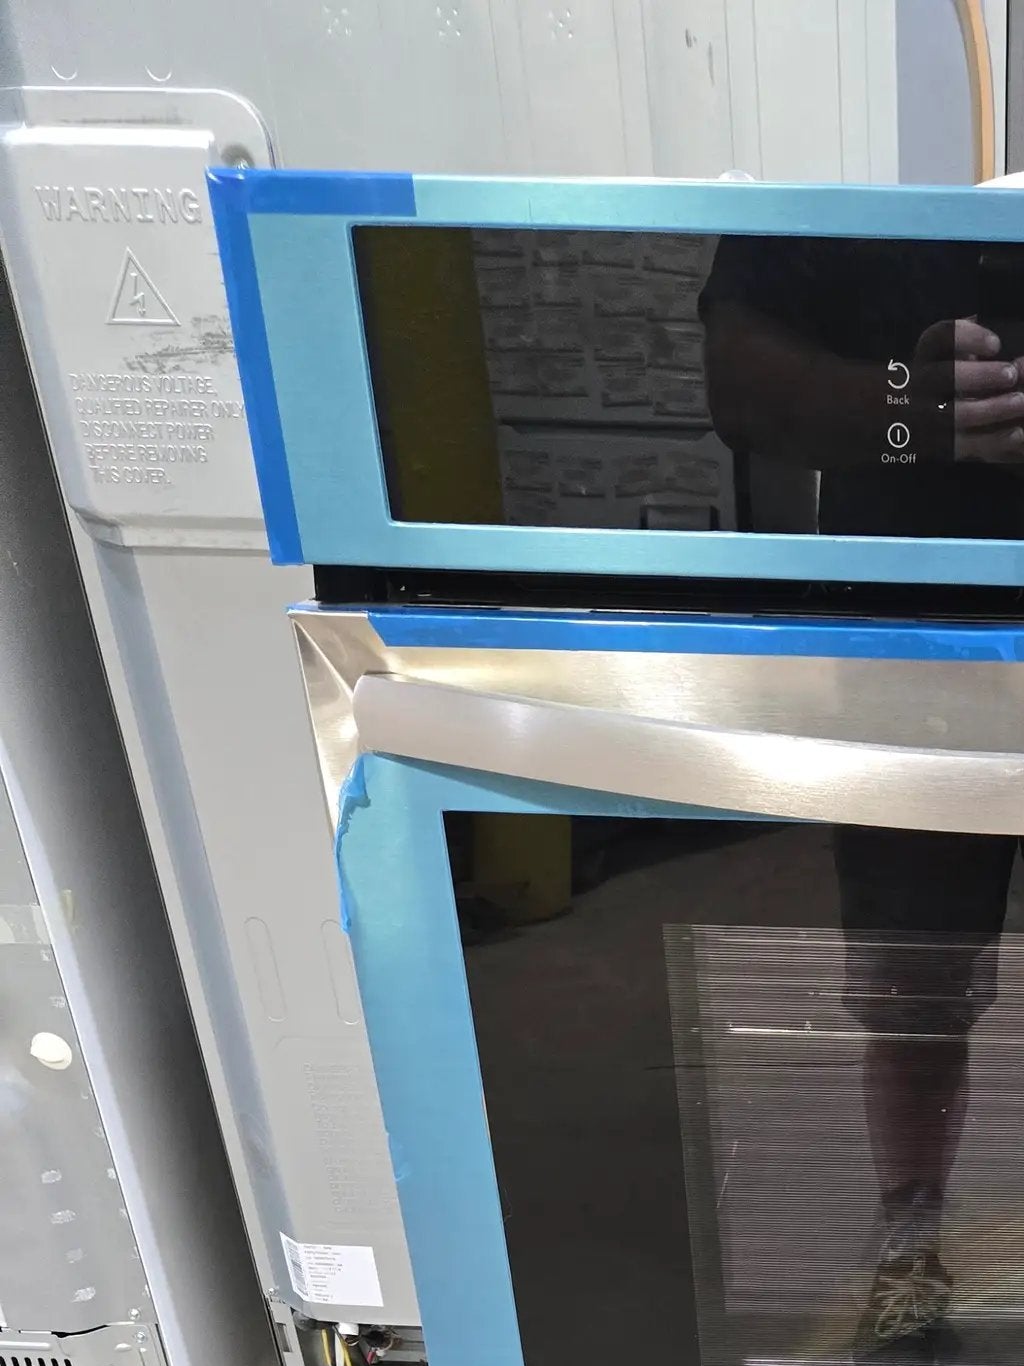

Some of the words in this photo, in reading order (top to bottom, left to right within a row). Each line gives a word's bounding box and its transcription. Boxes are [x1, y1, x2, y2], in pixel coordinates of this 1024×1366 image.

[33, 184, 203, 224] WARNING
[69, 373, 151, 392] DANGEROUS
[75, 397, 141, 416] QUALIFIED
[145, 399, 208, 417] REPAIRER
[886, 394, 910, 406] Back
[80, 420, 163, 439] DISCONNECT
[166, 422, 215, 440] POWER
[84, 443, 137, 461] BEFORE
[138, 444, 208, 463] REMOVING
[881, 453, 916, 465] On-Off
[89, 466, 121, 484] THIS
